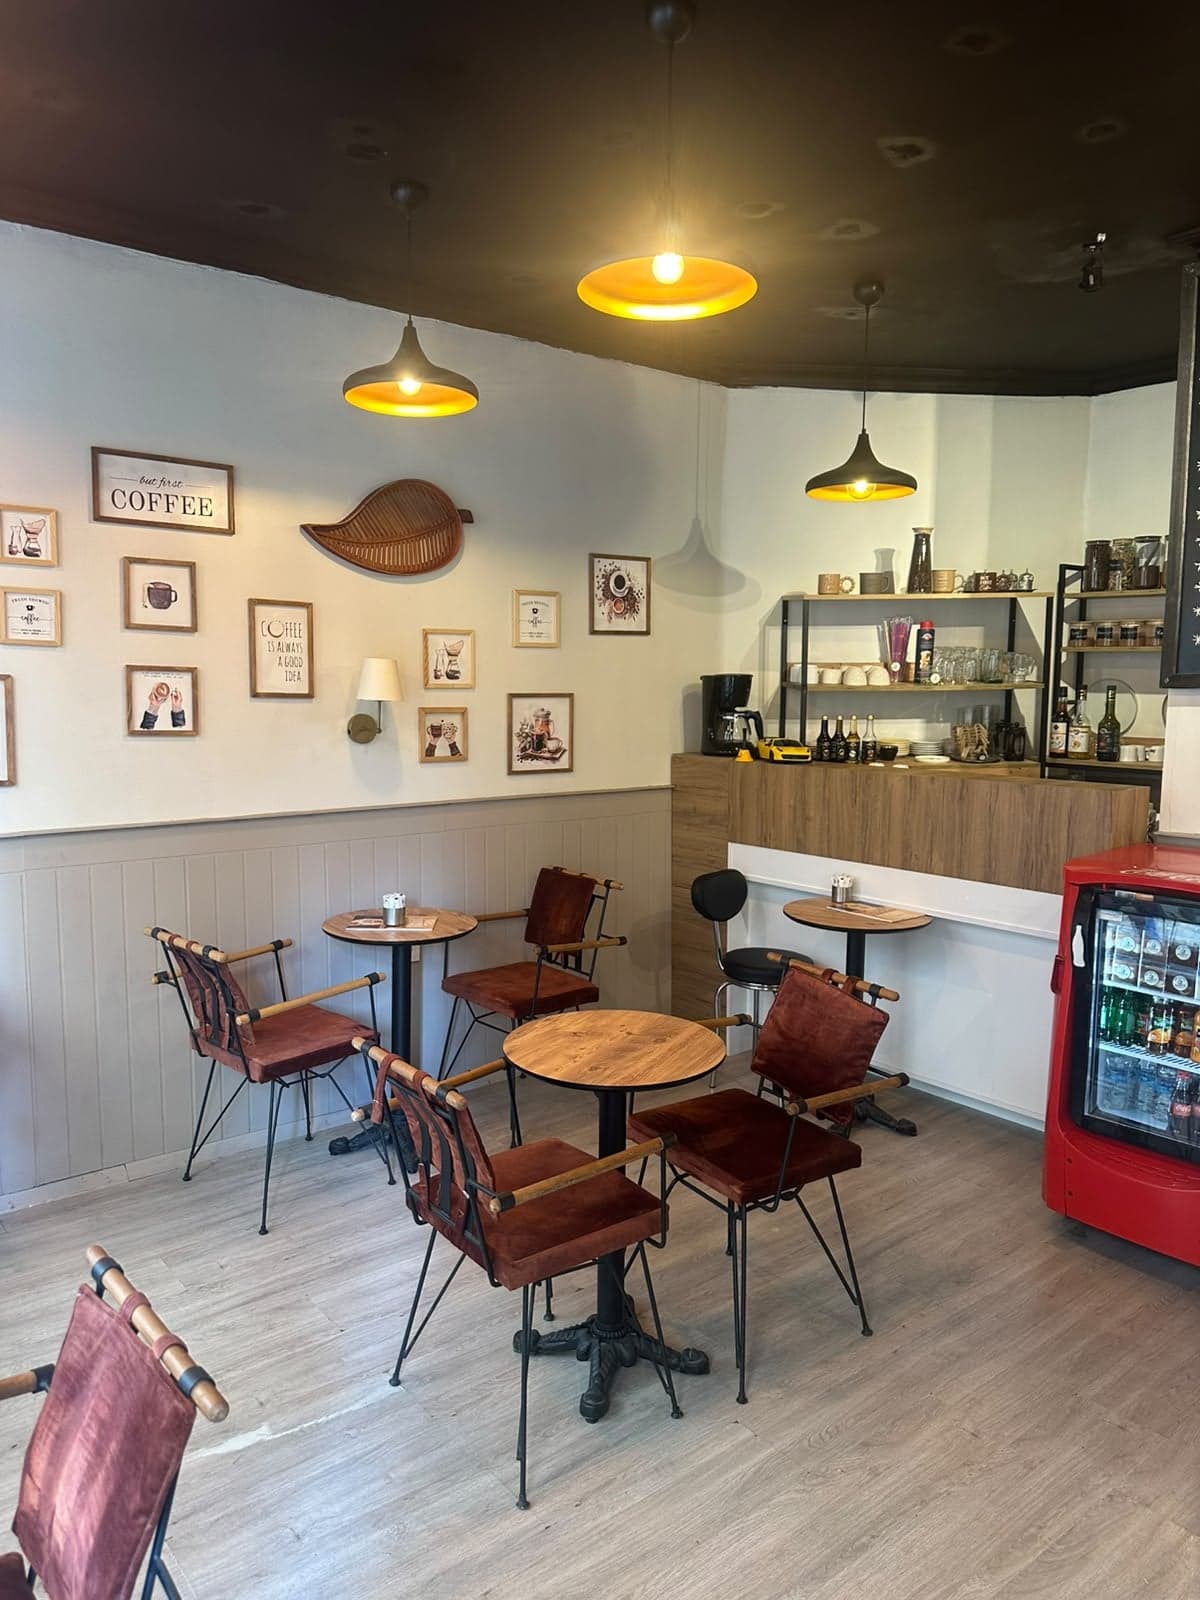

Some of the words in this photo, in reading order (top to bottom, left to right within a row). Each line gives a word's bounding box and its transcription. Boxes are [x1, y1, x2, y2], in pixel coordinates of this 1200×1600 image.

[139, 475, 157, 486] but
[158, 477, 183, 488] first
[111, 488, 213, 517] COFFEE
[261, 620, 302, 638] COFFEE
[267, 641, 275, 653] IS
[277, 641, 303, 653] ALWAYS
[278, 656, 283, 668] A
[284, 656, 304, 668] GOOD
[285, 670, 302, 682] IDEA
